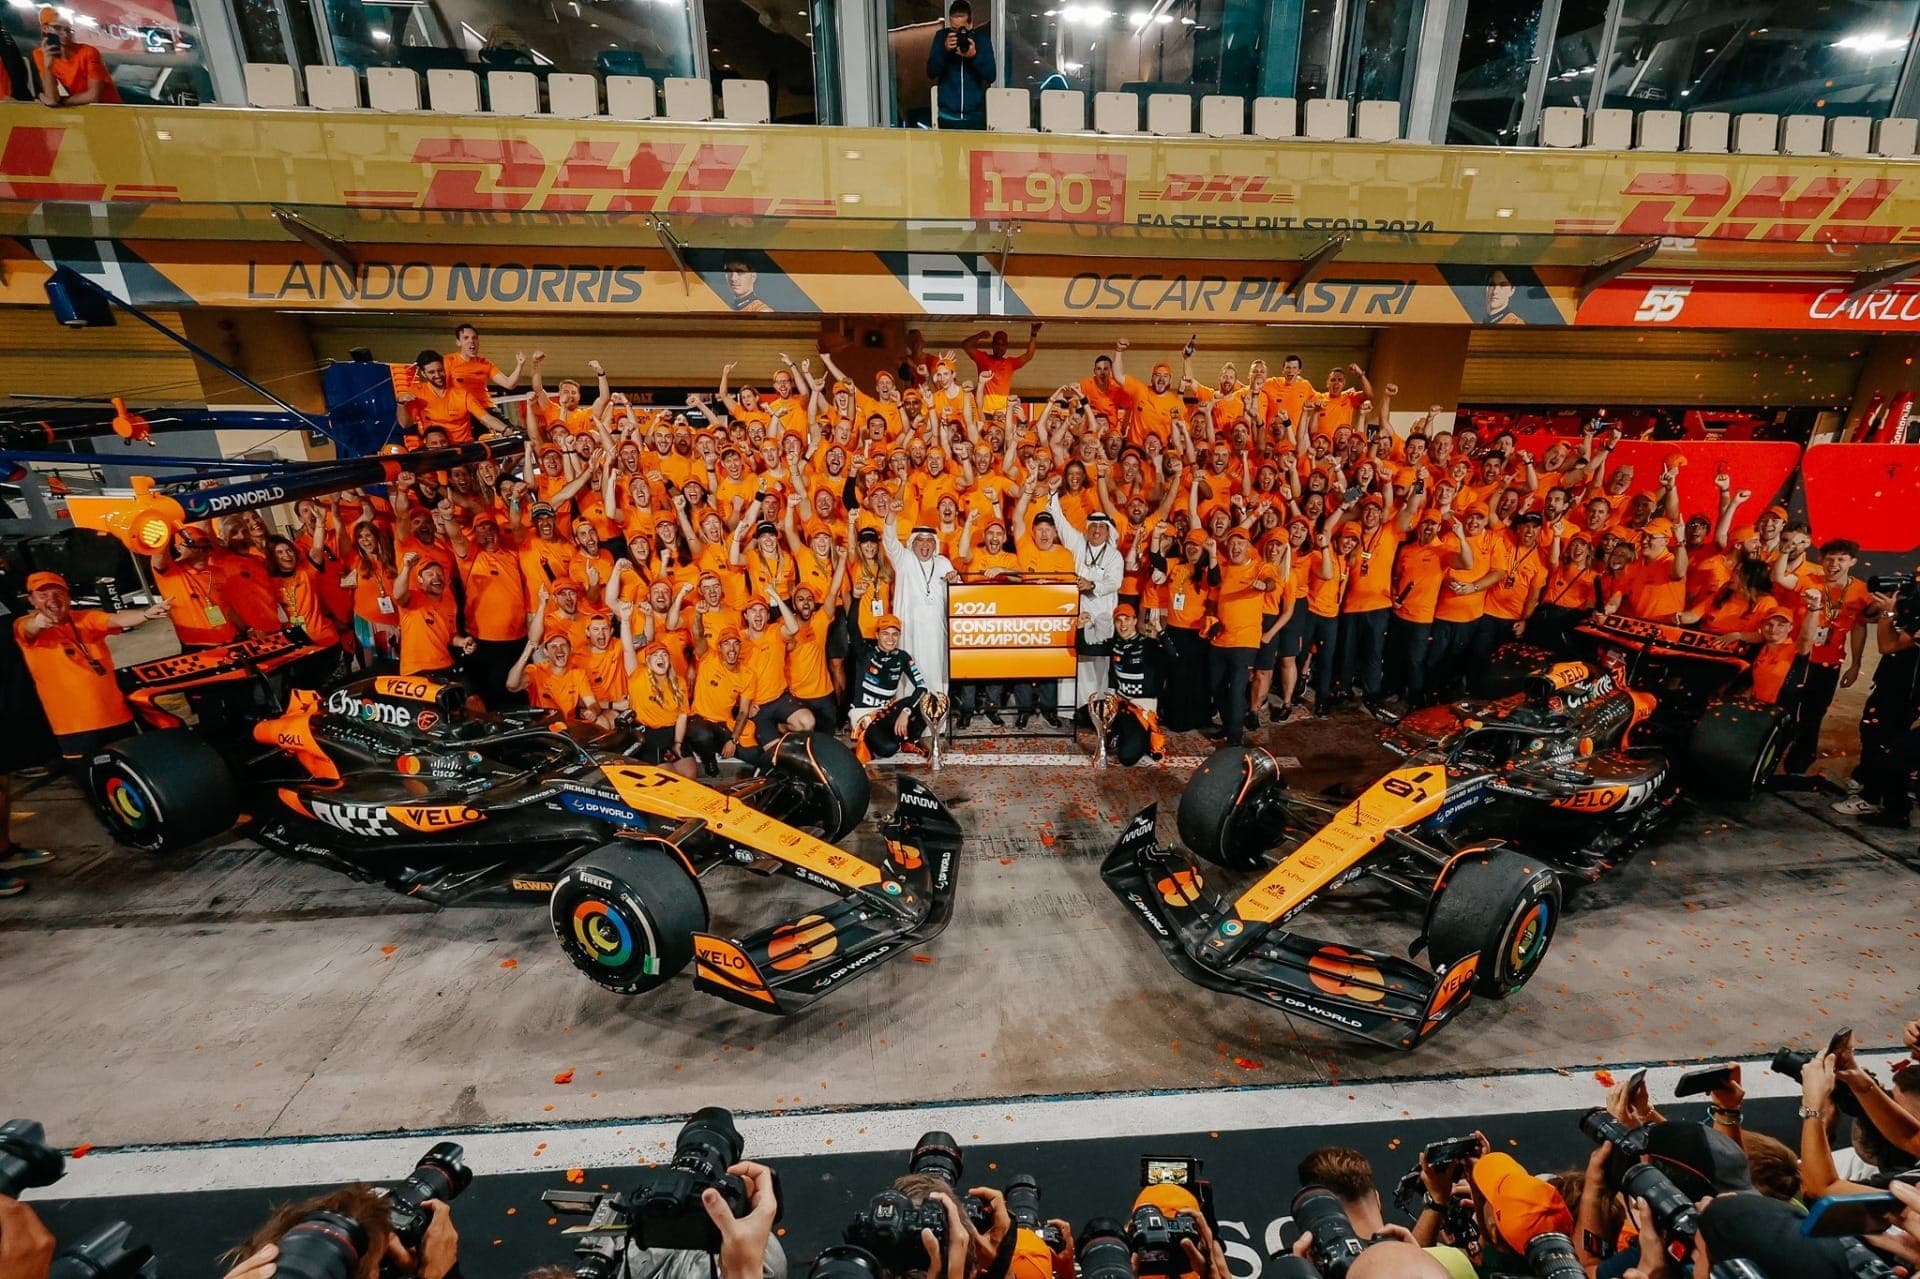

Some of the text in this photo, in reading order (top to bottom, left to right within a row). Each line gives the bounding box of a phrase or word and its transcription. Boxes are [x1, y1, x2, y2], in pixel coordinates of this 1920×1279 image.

[411, 138, 774, 214] DHL
[1160, 174, 1275, 202] DHL
[1614, 172, 1903, 243] DHL
[248, 259, 646, 303] LANDO NORRIS
[1064, 272, 1418, 315] OSCAR PIASTRI
[1633, 285, 1694, 322] 55
[209, 486, 285, 511] DP WORLD
[953, 601, 997, 615] 2024
[952, 632, 1052, 646] CHAMPIONS
[1556, 666, 1585, 684] VELO
[386, 679, 428, 698] VELO
[328, 688, 411, 728] Chrome
[563, 783, 621, 801] RICHARD MILLE
[406, 807, 484, 827] VELO
[600, 806, 634, 820] WORLD
[807, 872, 841, 892] SENNA
[699, 948, 746, 970] VELO
[830, 945, 891, 979] DP WORLD
[1442, 968, 1475, 996] VELO
[1284, 997, 1363, 1029] DP WORLD
